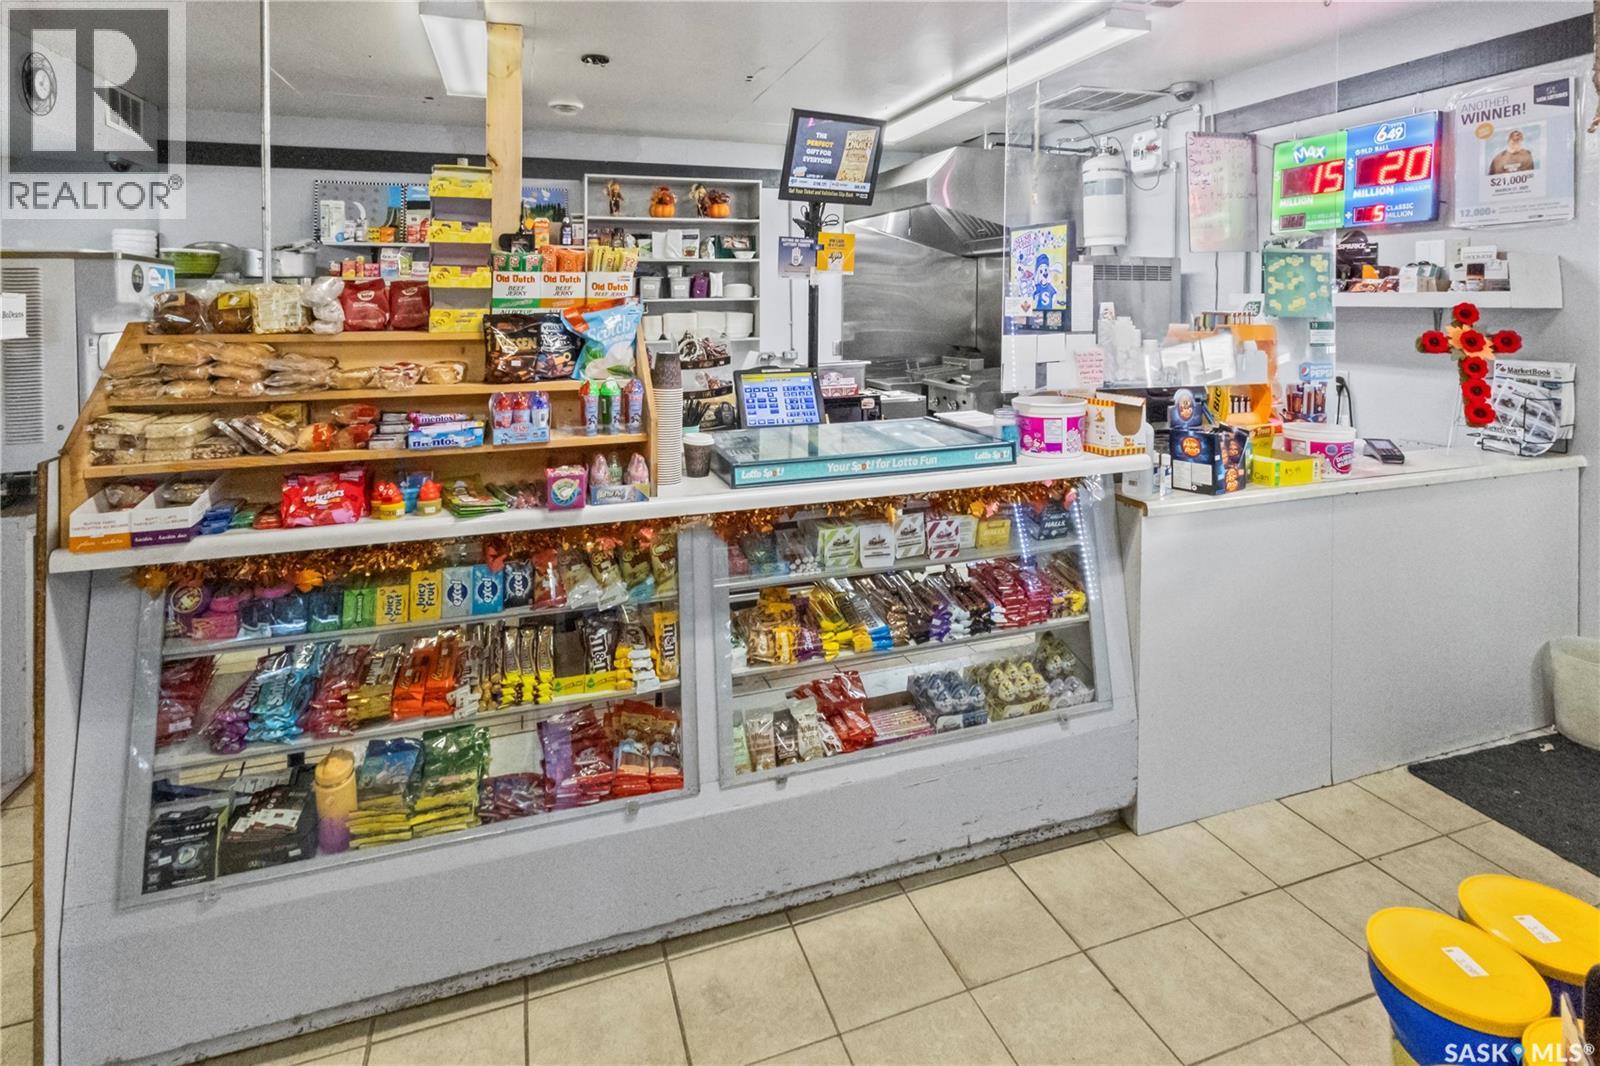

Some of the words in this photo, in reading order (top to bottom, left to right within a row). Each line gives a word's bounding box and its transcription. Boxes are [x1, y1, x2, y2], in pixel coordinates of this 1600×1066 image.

[1461, 95, 1510, 112] ANOTHER
[1461, 103, 1526, 125] WINNER!
[806, 139, 834, 148] PERFECT
[802, 156, 833, 165] EVERYONE
[1293, 145, 1328, 163] MAX
[1378, 146, 1433, 185] 20
[1312, 160, 1344, 193] 15
[1353, 186, 1394, 198] MILLION
[1280, 197, 1313, 207] MILLION
[1386, 202, 1414, 211] CLASSIC
[1373, 205, 1385, 222] 5
[1386, 210, 1414, 218] MILLION
[496, 274, 509, 283] Old
[512, 274, 535, 283] Dutch
[543, 274, 556, 283] Old
[559, 274, 581, 283] Dutch
[591, 282, 606, 291] Old
[607, 283, 628, 291] Dutch
[1507, 367, 1551, 376] MarketBook
[1213, 387, 1222, 412] BIC
[827, 462, 849, 472] Your
[851, 459, 875, 472] Spot!
[876, 459, 890, 469] for
[892, 457, 918, 469] Lotto
[920, 455, 938, 465] Fun
[741, 470, 762, 480] Lotto
[1045, 520, 1066, 528] HALLS
[482, 577, 493, 603] excel
[512, 571, 522, 597] excel
[416, 583, 426, 609] Juicy
[426, 581, 436, 607] Fruit
[452, 580, 463, 606] excel
[384, 594, 393, 617] Juicy
[394, 593, 402, 616] Fruit
